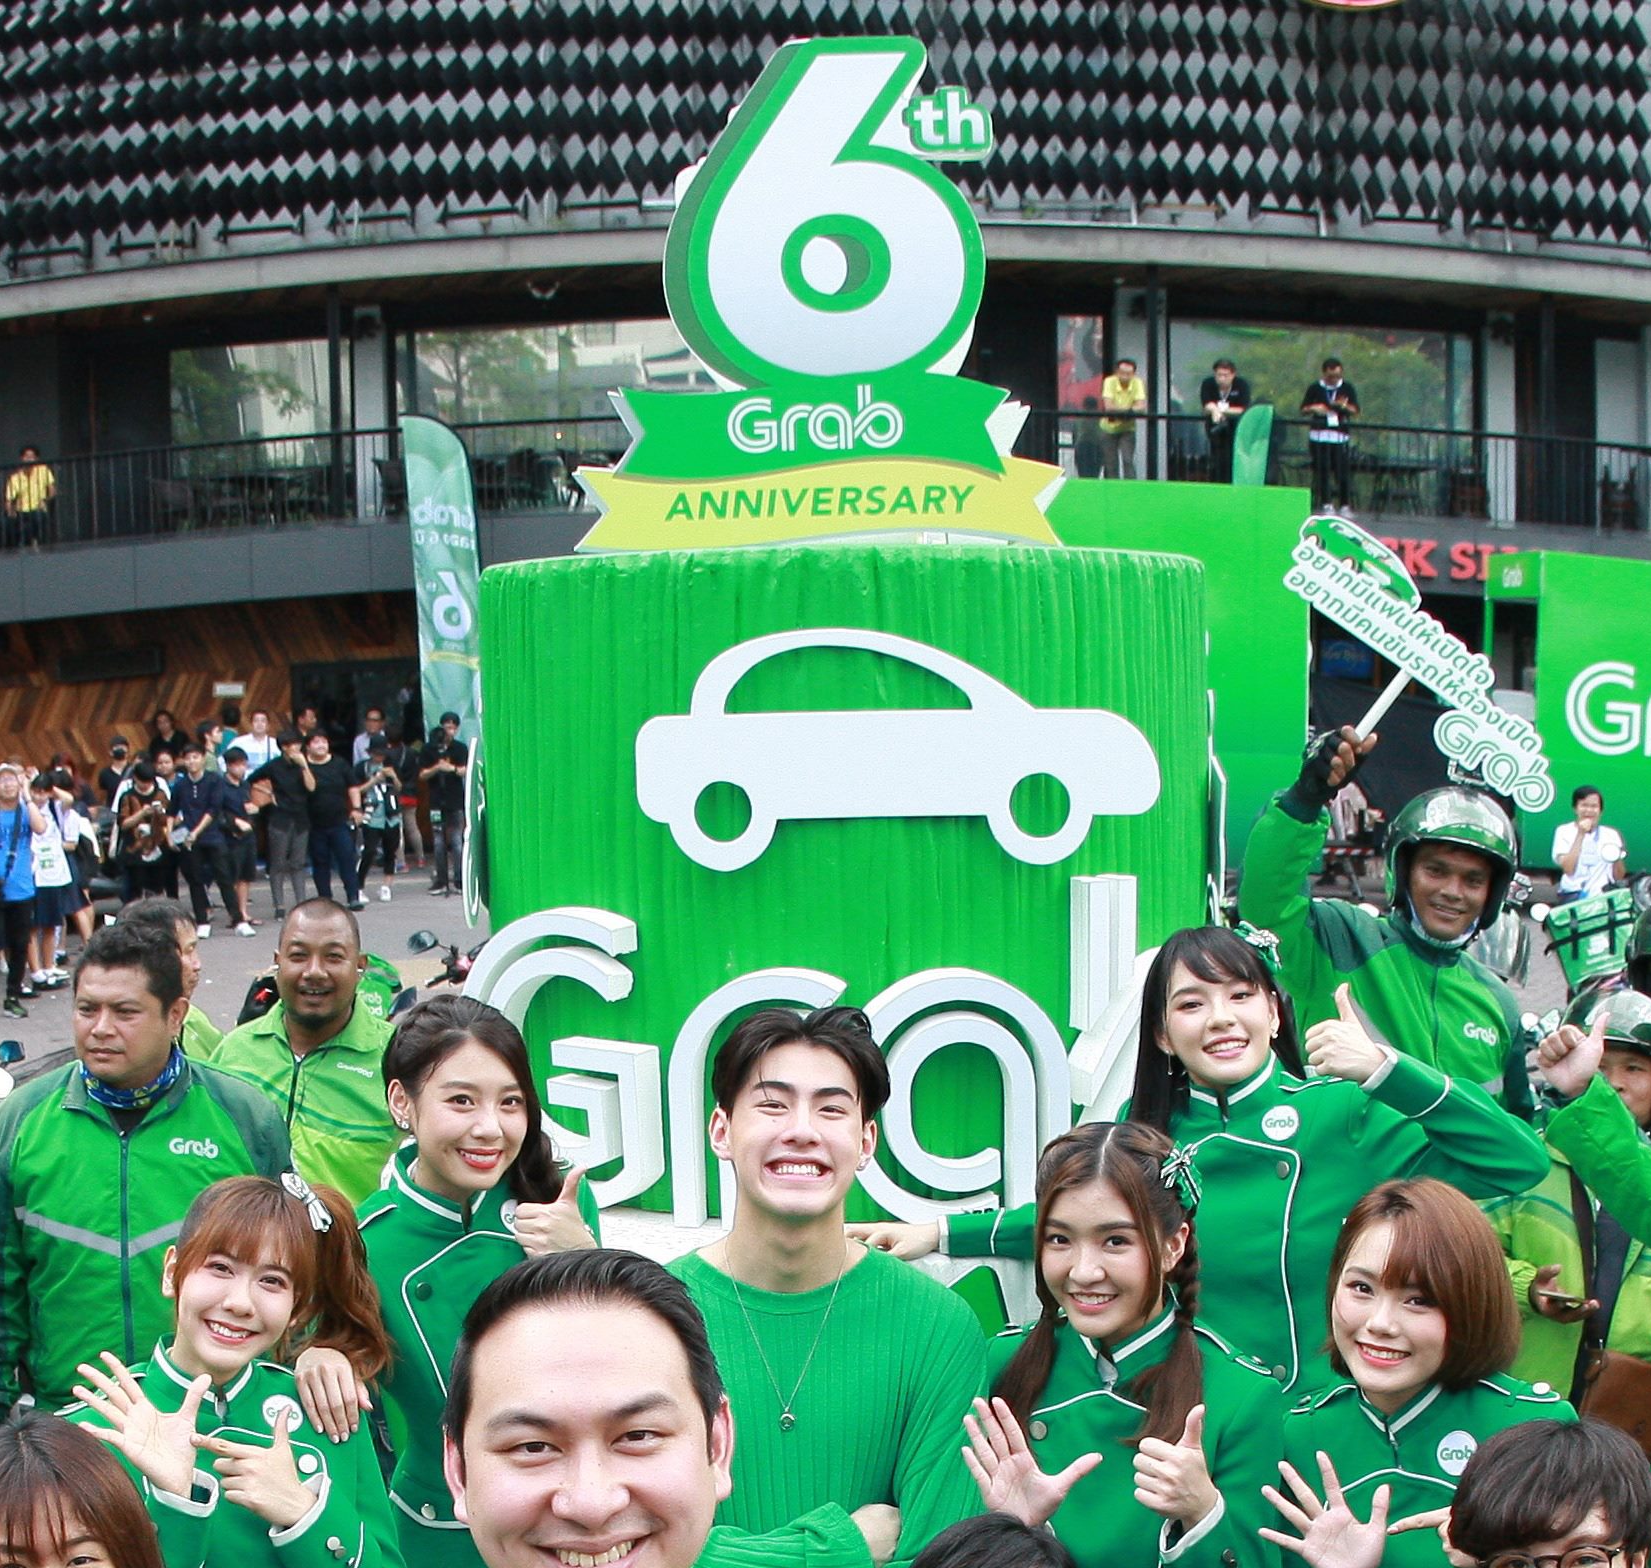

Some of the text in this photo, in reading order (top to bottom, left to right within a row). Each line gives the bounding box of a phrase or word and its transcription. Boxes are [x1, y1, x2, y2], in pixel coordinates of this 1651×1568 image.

[708, 52, 987, 378] 6th
[726, 385, 904, 454] Grab
[664, 485, 976, 522] ANNIVERSARY
[1296, 541, 1491, 688] อยากมีแฟนให้เปิดใจ
[1288, 570, 1537, 753] อยากมีคนขับรถให้ต้องเปิด
[1438, 713, 1551, 809] Grab
[1462, 1021, 1497, 1047] Grab
[1264, 1116, 1295, 1129] Grab
[168, 1137, 219, 1160] Grab
[266, 1406, 299, 1422] Gb
[1439, 1445, 1473, 1462] Grab
